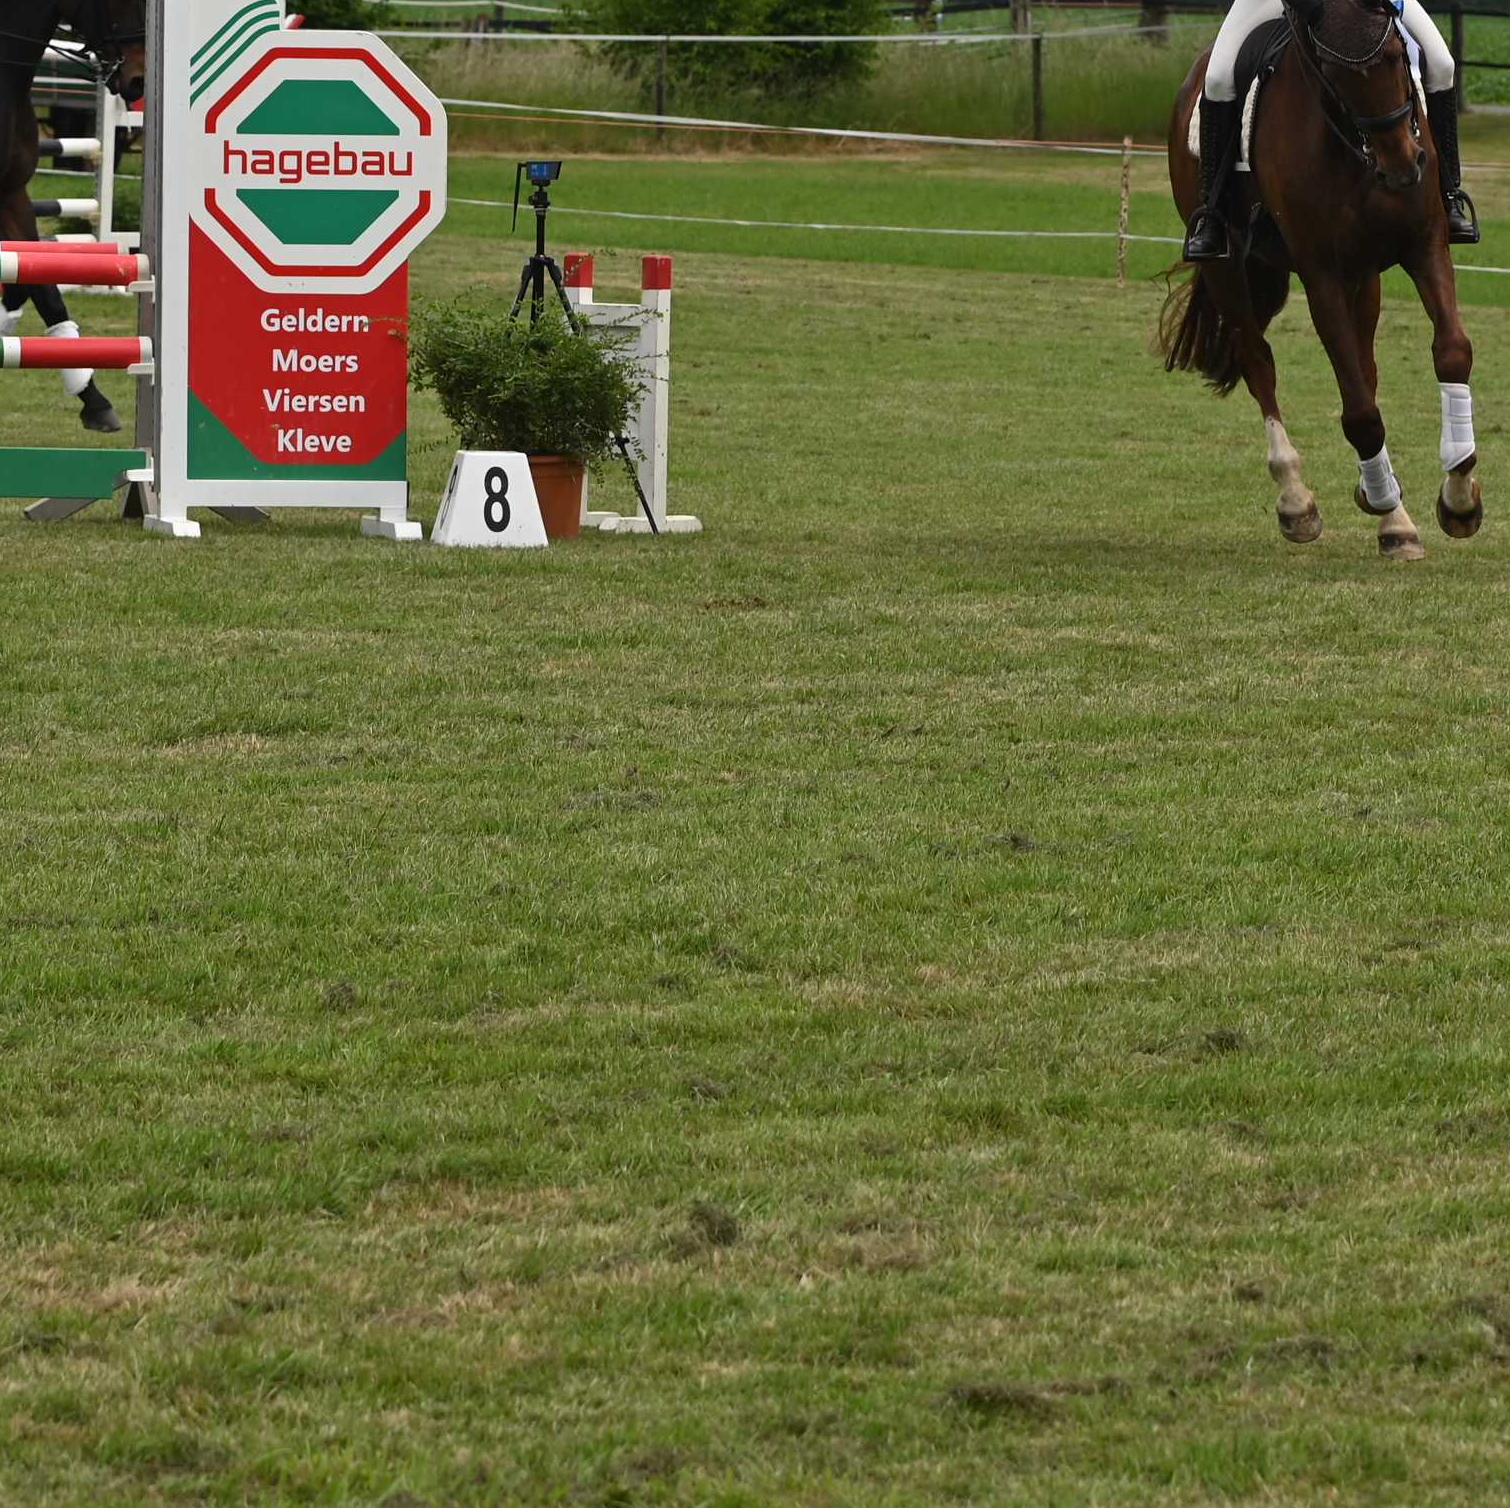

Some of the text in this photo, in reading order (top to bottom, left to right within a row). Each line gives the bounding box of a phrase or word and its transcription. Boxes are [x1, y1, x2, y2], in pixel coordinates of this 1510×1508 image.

[223, 140, 413, 184] hagebau
[260, 308, 369, 333] Geldern
[272, 349, 358, 372] Moers
[262, 388, 365, 412] Viersen
[277, 428, 351, 452] Kleve
[484, 466, 511, 533] 8
